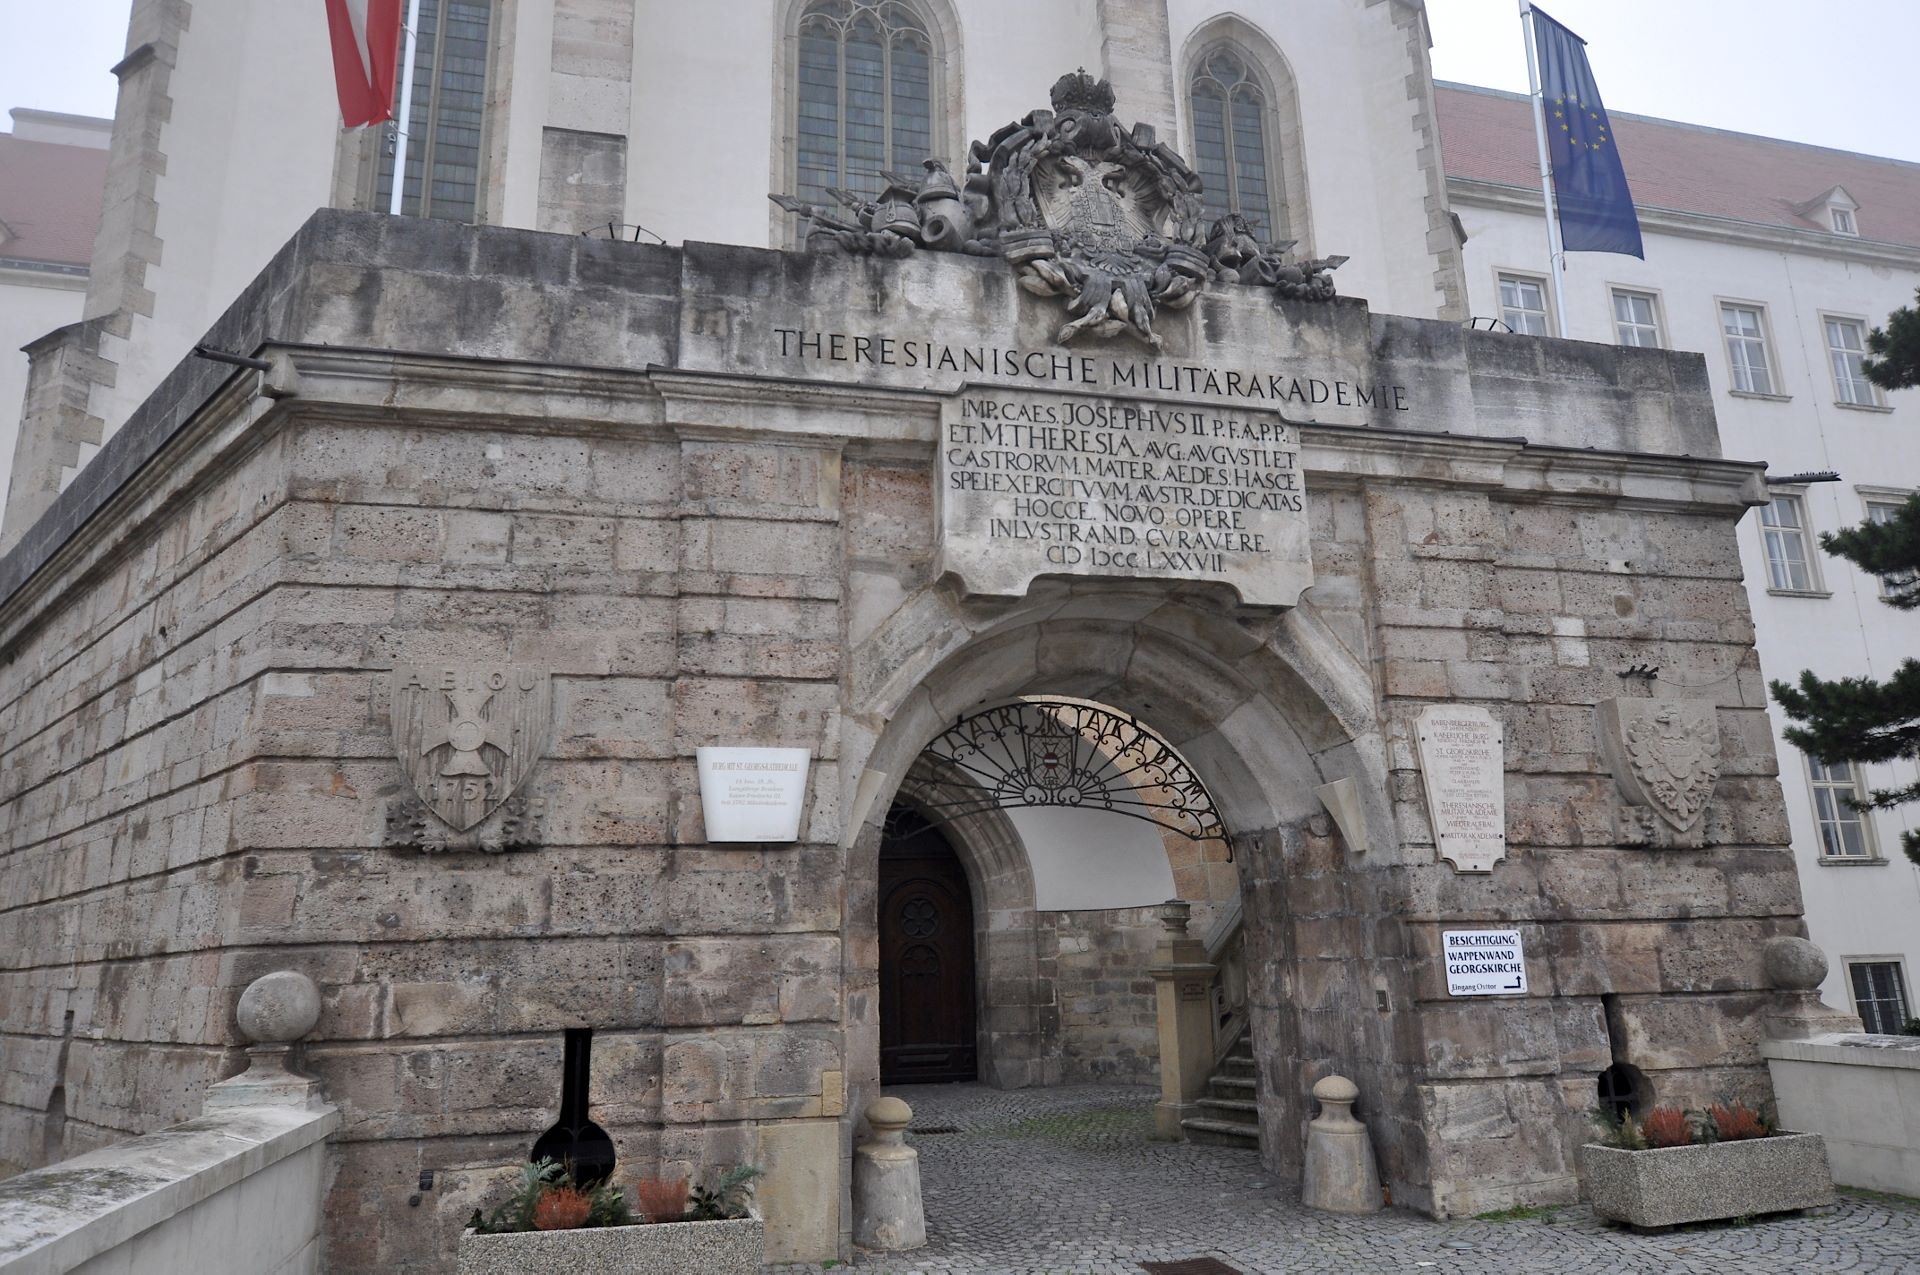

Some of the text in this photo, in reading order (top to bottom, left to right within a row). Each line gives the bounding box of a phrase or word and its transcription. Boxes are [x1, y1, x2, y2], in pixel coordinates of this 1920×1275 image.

[774, 329, 1410, 411] THERESIANISCHE MILITÄRAKADEMIE
[961, 399, 999, 420] IMP.
[1001, 403, 1060, 424] CAES.
[1062, 402, 1187, 435] JOSEPHVS
[948, 448, 1300, 491] CASTRORVM. MATER. AEDES. HASCE
[1200, 488, 1303, 512] DEDICATAS
[1014, 498, 1246, 530] HOCCE. NOVO. OPERE
[1146, 528, 1271, 553] CVRAVERE.
[1449, 934, 1516, 946] BESICHTIGUNG
[1448, 950, 1515, 961] WAPPENWAND
[1449, 963, 1523, 974] GEORGSKIRCHE
[1451, 983, 1477, 992] Eingang
